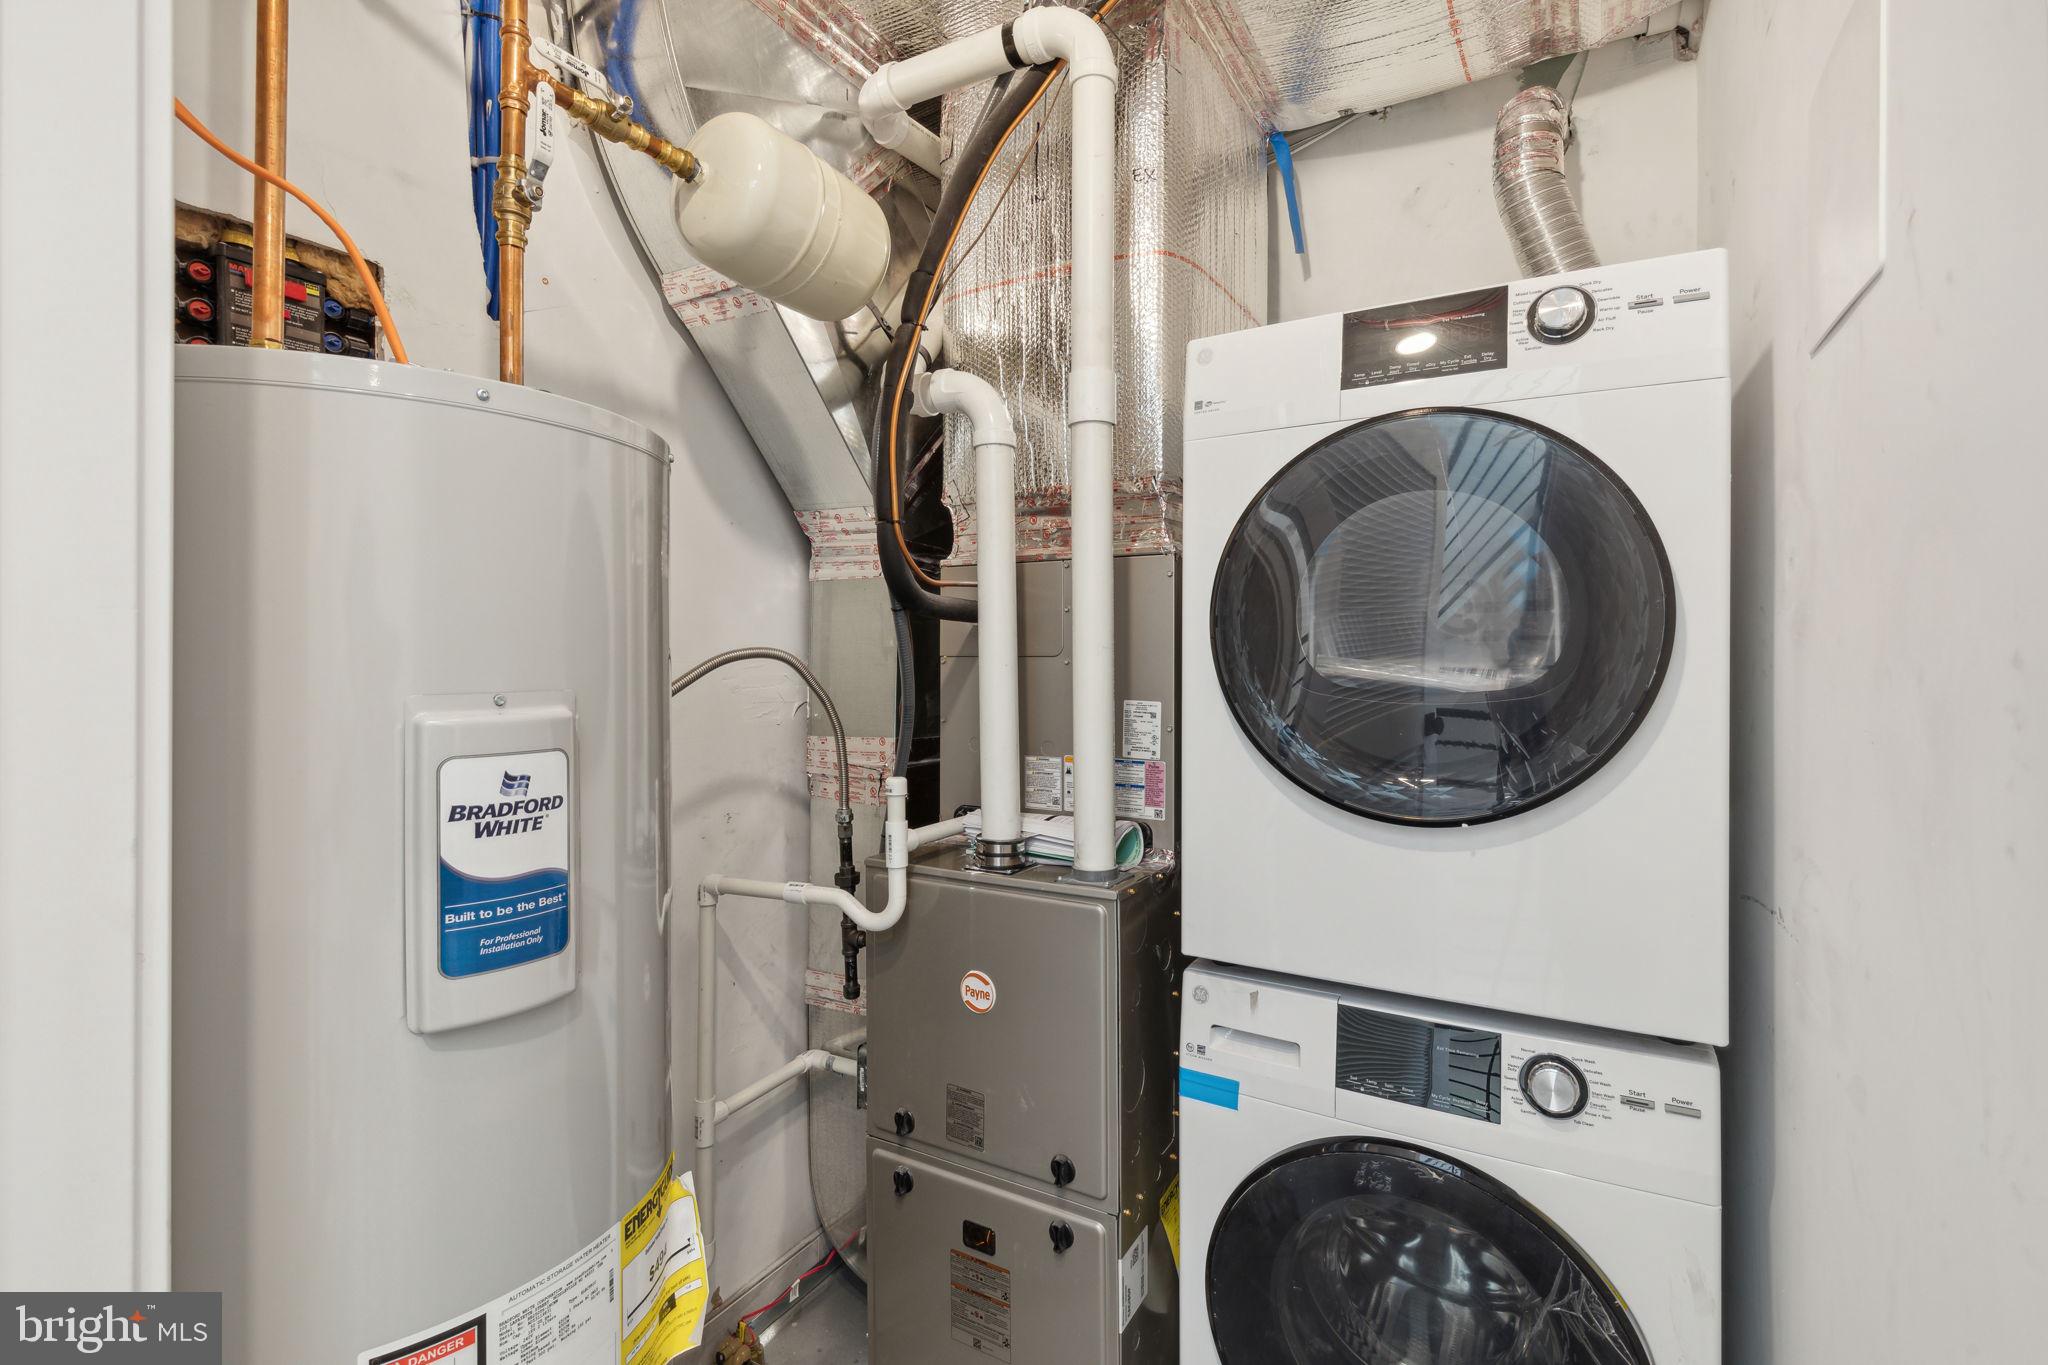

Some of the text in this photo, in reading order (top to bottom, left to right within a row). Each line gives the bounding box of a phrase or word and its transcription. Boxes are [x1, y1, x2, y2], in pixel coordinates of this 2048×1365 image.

[565, 61, 590, 77] Jomar
[540, 109, 548, 136] Jomar
[1132, 168, 1157, 183] EX
[448, 795, 564, 822] BRADFORD
[474, 815, 544, 839] WHITE
[445, 911, 476, 924] Built
[479, 910, 493, 919] to
[496, 906, 514, 916] be
[517, 901, 536, 912] the
[480, 926, 542, 947] For Professional
[480, 934, 544, 956] Installation Only
[965, 984, 991, 1001] Payne
[1629, 1089, 1646, 1098] Start
[1671, 1097, 1693, 1106] Power
[508, 1233, 612, 1303] AUTOMATIC STORAGE WATER HEATER
[408, 1337, 465, 1365] DANGER
